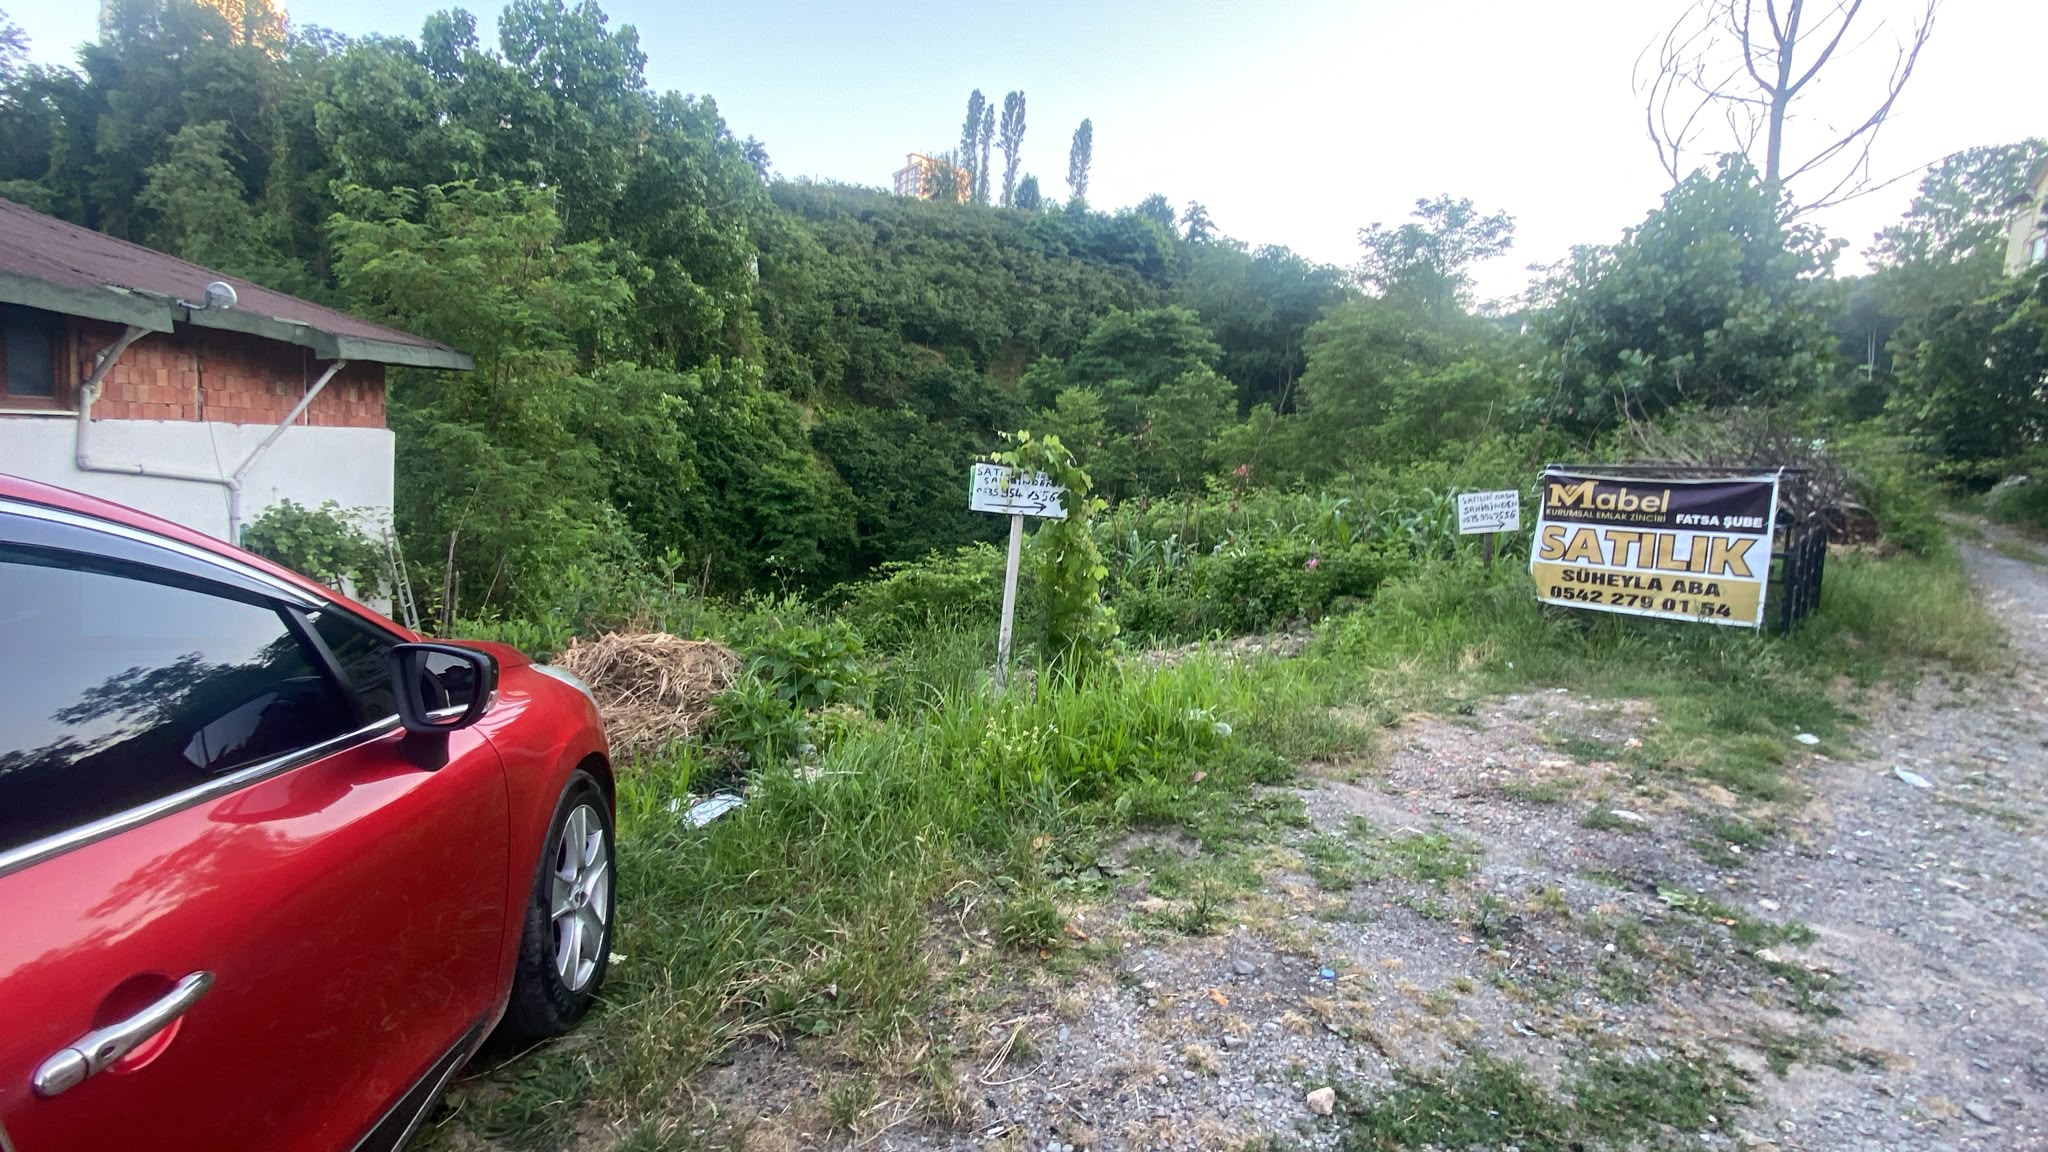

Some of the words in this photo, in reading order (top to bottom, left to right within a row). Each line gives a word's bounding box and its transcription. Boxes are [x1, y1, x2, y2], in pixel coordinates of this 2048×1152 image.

[1547, 480, 1671, 513] Mabel
[1546, 507, 1594, 519] KURUMSAL
[1596, 511, 1628, 521] EMLAK
[1675, 513, 1719, 527] FATSA
[1723, 515, 1764, 530] ŞUBE
[1539, 525, 1759, 577] SATILIK
[1561, 568, 1663, 592] SÜHEYLA
[1671, 579, 1721, 597] ABA
[1550, 585, 1603, 604] 0542
[1610, 592, 1653, 609] 279
[1662, 597, 1691, 613] 01
[1700, 602, 1731, 618] 54
